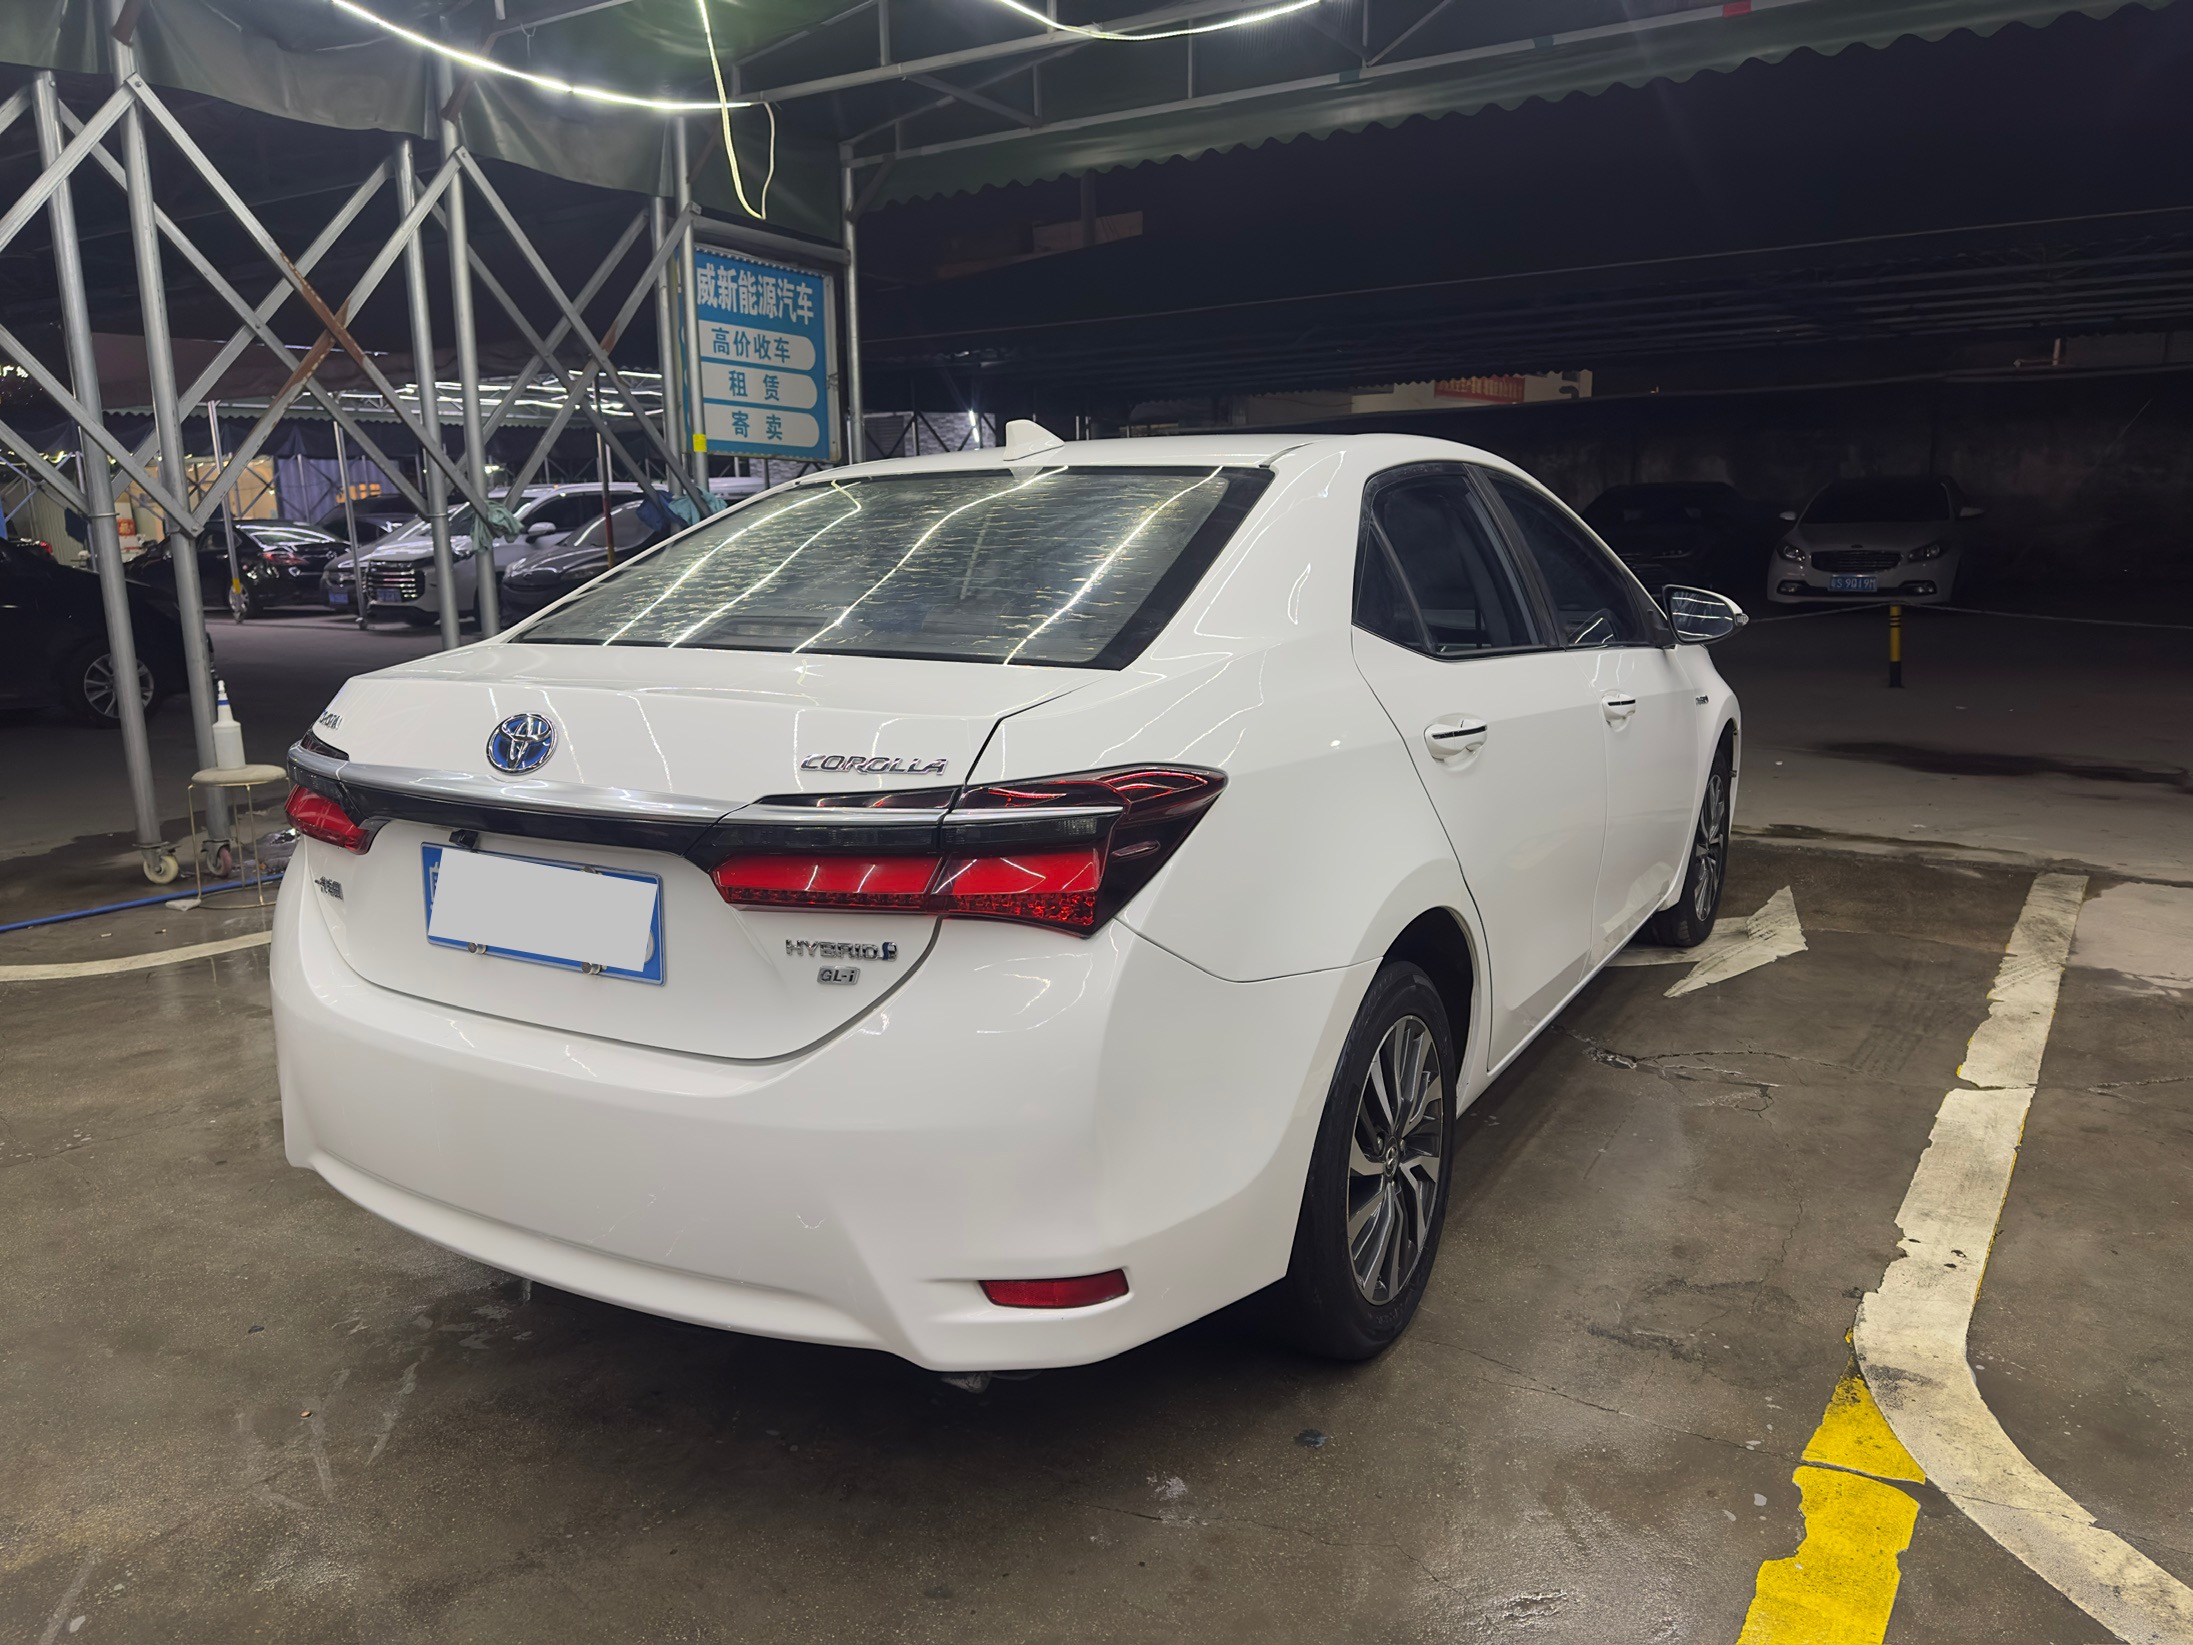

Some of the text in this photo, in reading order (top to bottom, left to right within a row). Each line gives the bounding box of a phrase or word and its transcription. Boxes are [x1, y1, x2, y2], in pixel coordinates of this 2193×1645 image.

[678, 259, 814, 325] 威新能源汽车
[711, 327, 790, 363] 高价收车
[729, 370, 780, 401] 租赁
[731, 410, 783, 441] 寄卖
[800, 753, 949, 776] COROLLA
[785, 938, 880, 960] HYBRID
